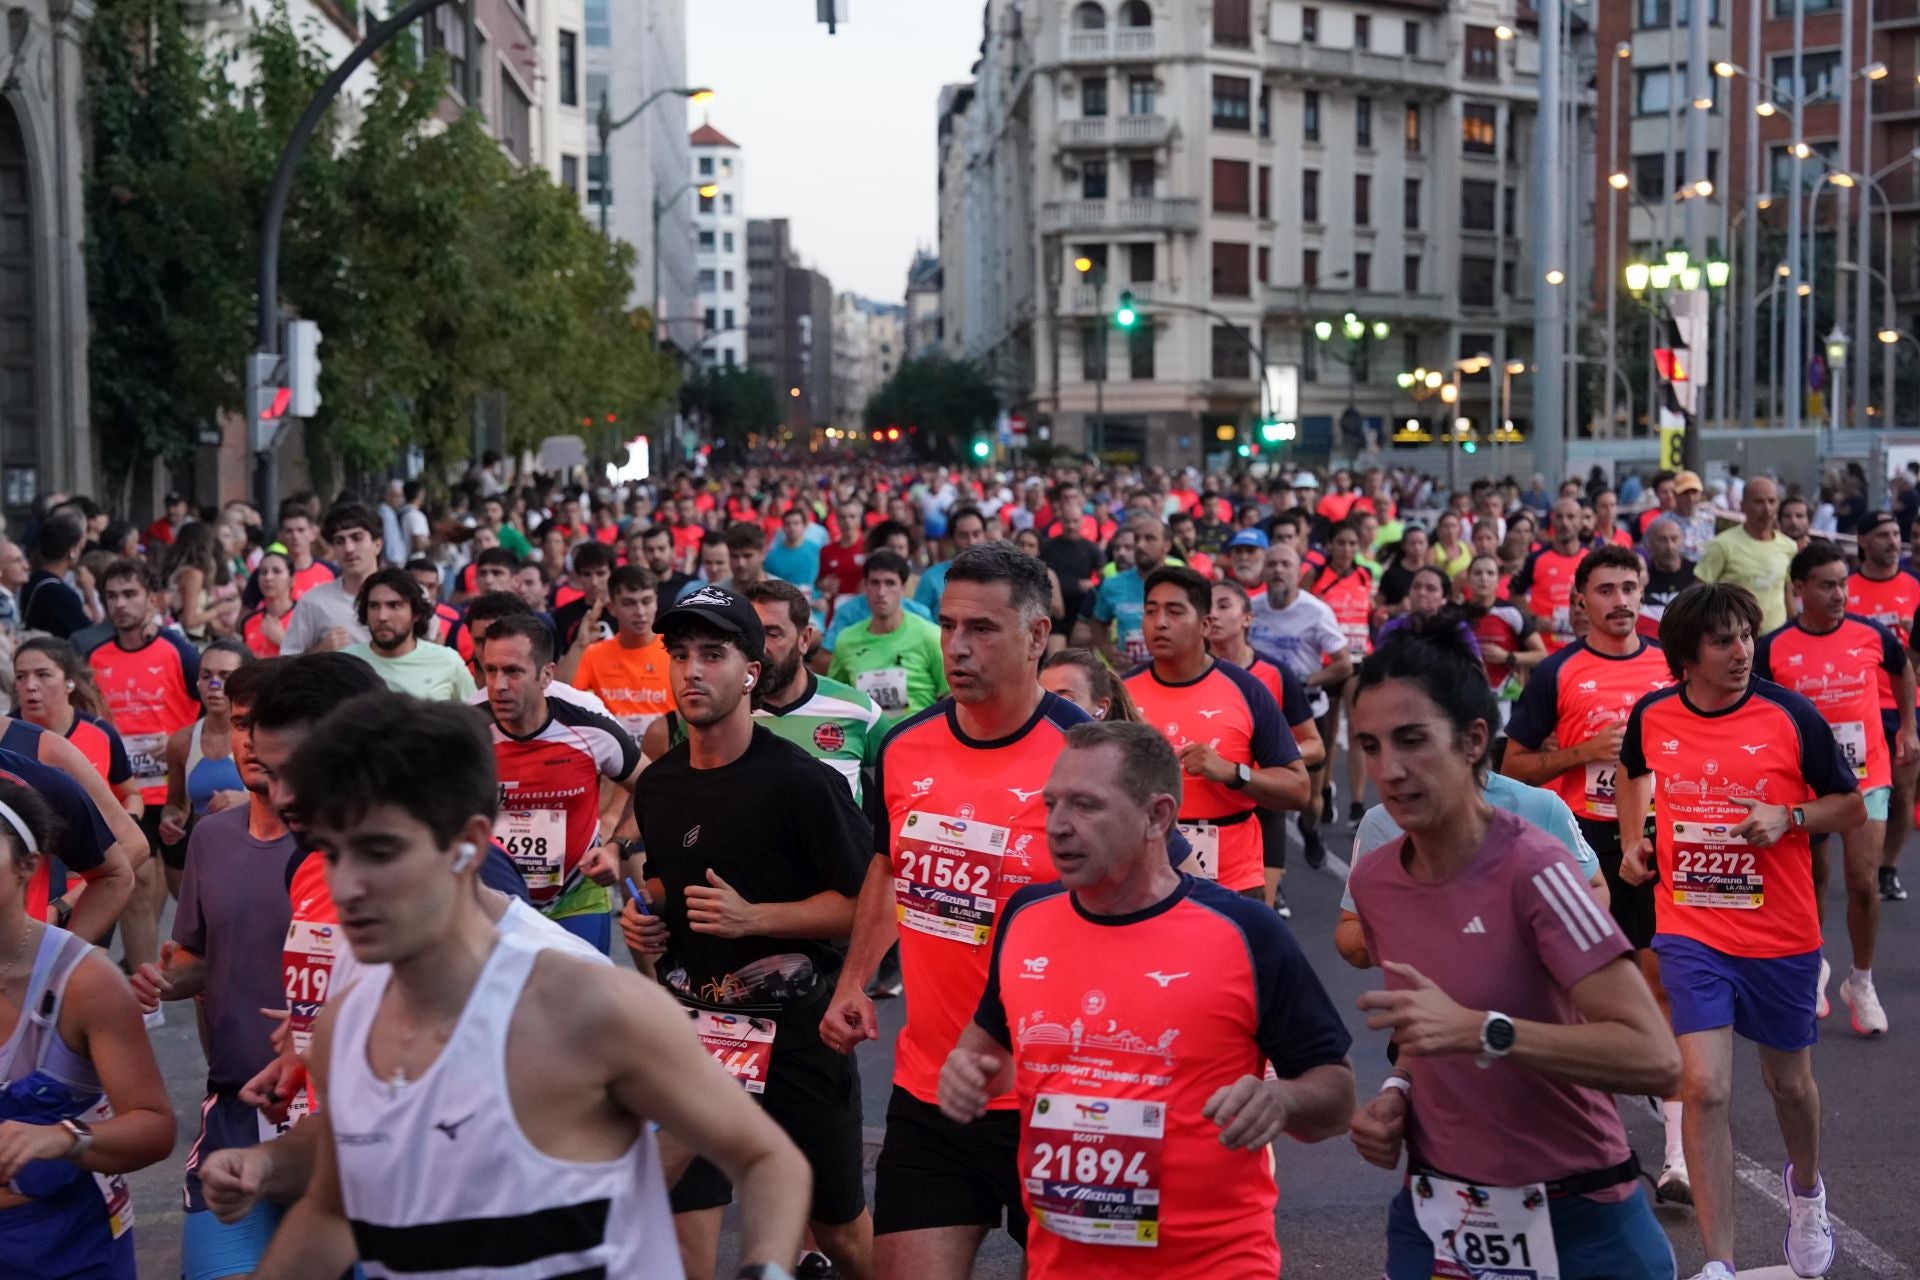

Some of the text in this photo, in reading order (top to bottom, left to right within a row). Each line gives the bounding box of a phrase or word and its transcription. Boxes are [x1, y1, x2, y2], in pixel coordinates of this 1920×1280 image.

[929, 844, 967, 857] ALFONSO
[1677, 850, 1756, 875] 22272
[900, 850, 991, 896] 21562
[1003, 874, 1032, 884] FEST
[1708, 875, 1743, 884] MIZUNO
[930, 891, 971, 907] MIZUNO
[285, 965, 329, 1002] 219
[1060, 1063, 1092, 1078] NIGHT
[1091, 1068, 1141, 1084] RUNNING
[1141, 1073, 1173, 1087] FEST
[1072, 1132, 1106, 1144] SCOTT
[1031, 1142, 1150, 1188] 21894
[1073, 1187, 1126, 1203] MIZUNO
[1441, 1229, 1532, 1268] 1851
